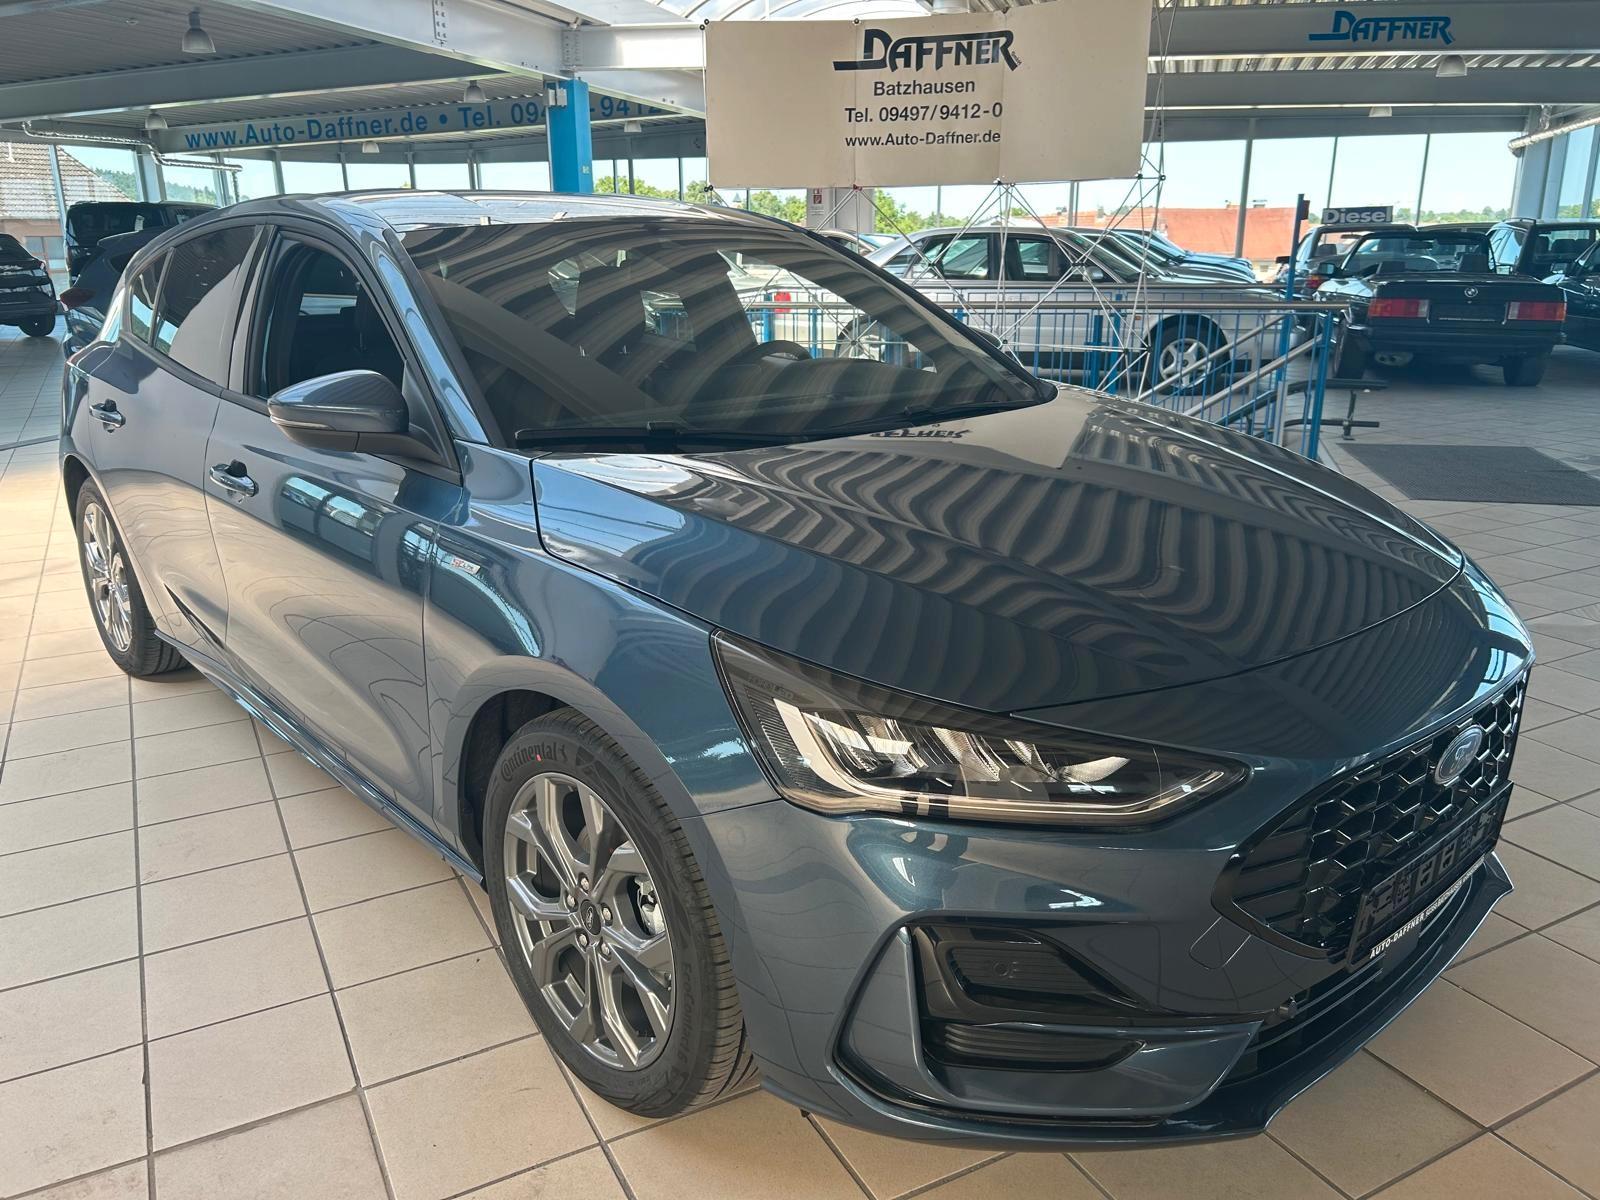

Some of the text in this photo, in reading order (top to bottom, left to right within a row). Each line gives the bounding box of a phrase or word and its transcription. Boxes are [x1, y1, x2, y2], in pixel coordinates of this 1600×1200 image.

[1309, 10, 1454, 46] DAFFNER
[833, 28, 1017, 72] DAFFNER
[873, 79, 975, 97] Batzhausen
[185, 110, 429, 149] www.Auto-Daffner.de
[457, 106, 500, 129] Tel.
[844, 102, 1003, 123] Tel. 09497/9412-0
[845, 129, 1001, 147] www.Auto-Daffner.de
[1322, 205, 1392, 224] Diesel
[501, 741, 557, 782] Continental
[1369, 912, 1425, 960] AUTO-DAFFNER
